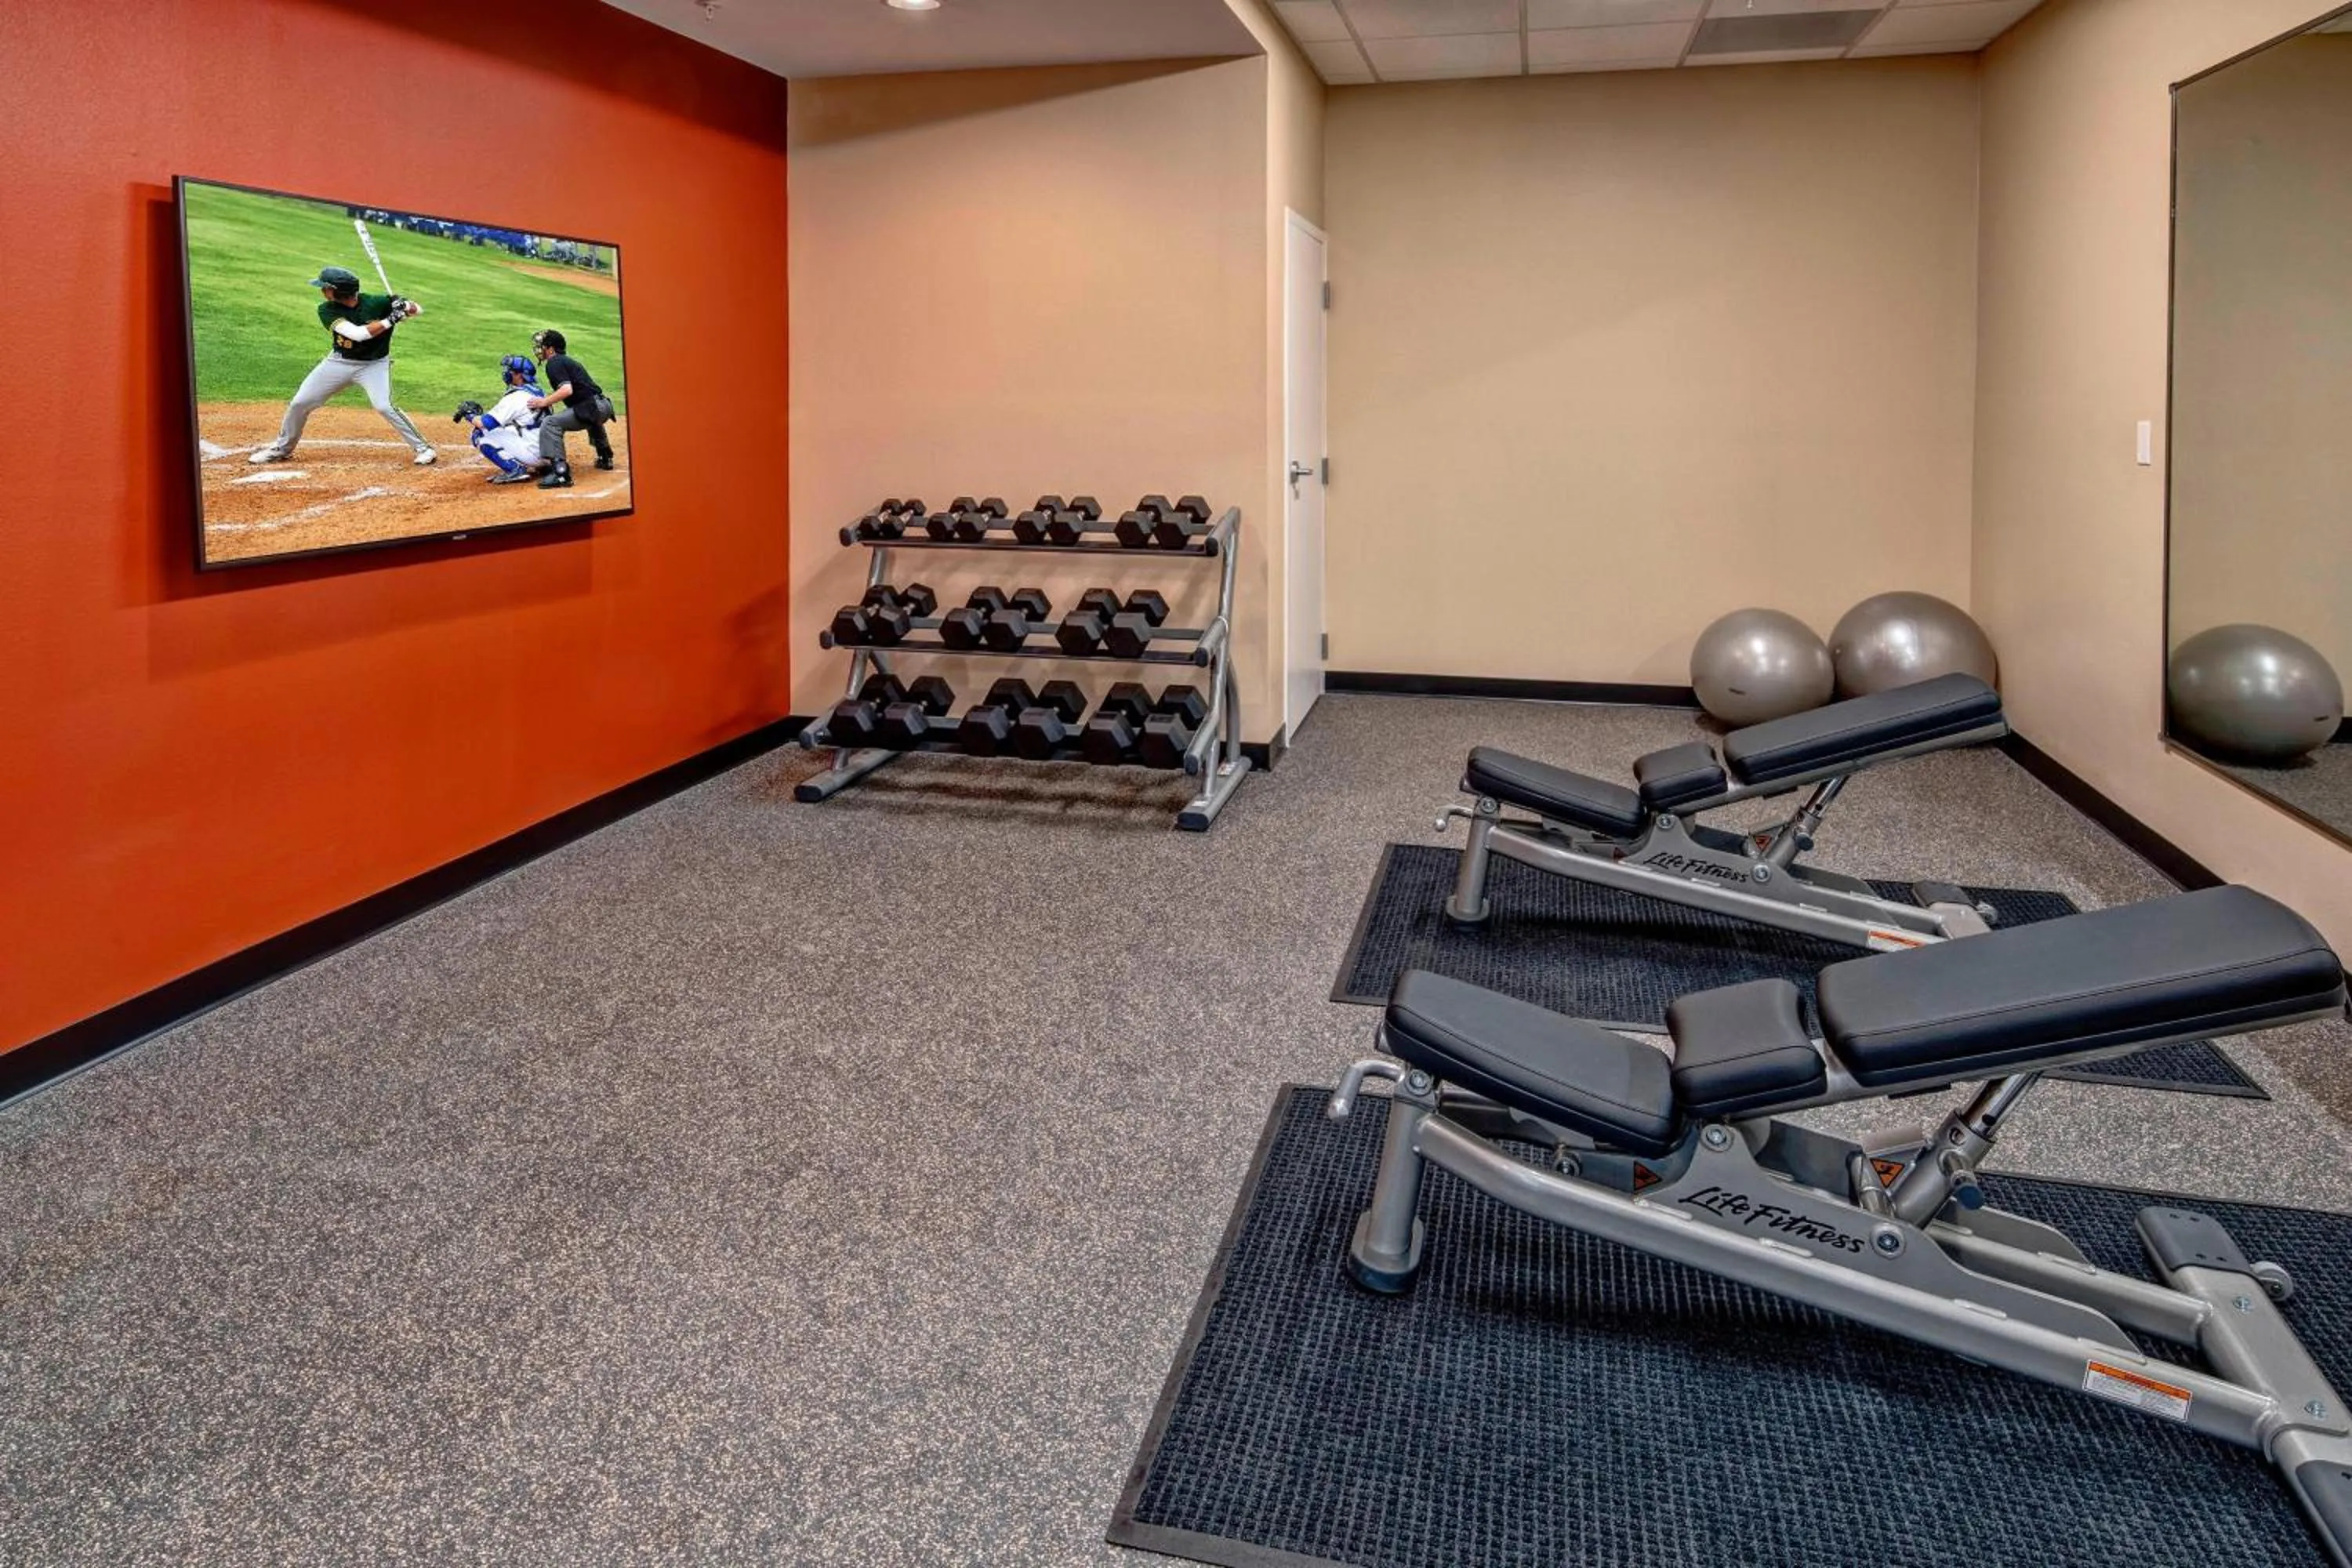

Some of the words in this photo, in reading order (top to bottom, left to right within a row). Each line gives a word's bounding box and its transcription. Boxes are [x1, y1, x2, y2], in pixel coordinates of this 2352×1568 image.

[1643, 852, 1683, 869] Life
[1681, 859, 1749, 883] Fitness
[1678, 1186, 1751, 1217] Life
[1744, 1203, 1865, 1253] Fitness
